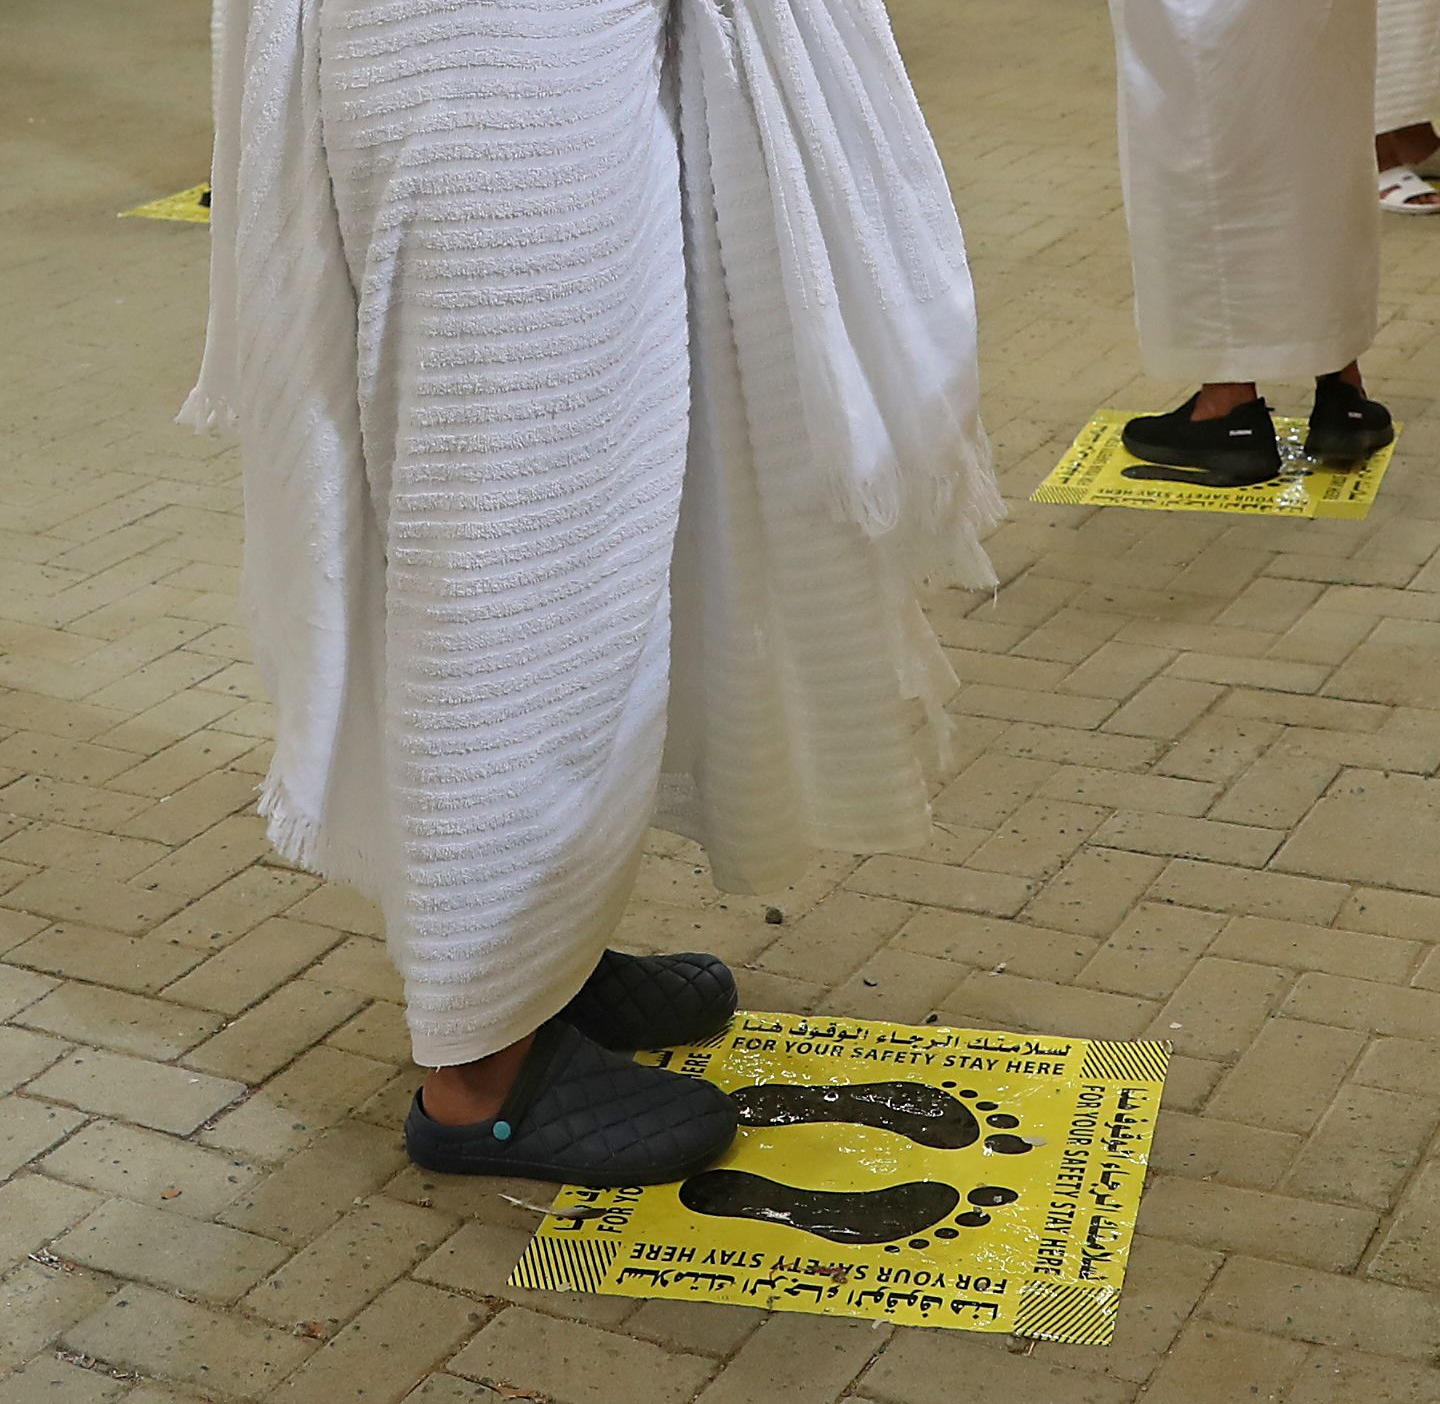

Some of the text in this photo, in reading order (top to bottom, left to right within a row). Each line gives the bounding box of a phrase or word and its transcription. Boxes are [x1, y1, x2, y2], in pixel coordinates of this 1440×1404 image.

[1096, 487, 1133, 496] HERE
[1136, 489, 1171, 499] STAY
[1175, 491, 1231, 502] SAFETY
[1235, 493, 1275, 504] YOUR
[732, 1036, 1067, 1076] FOR YOUR SAFETY STAY HERE
[742, 1018, 1072, 1057] لسلامتك الرجاء الوقوف هنا
[1033, 1084, 1106, 1277] FOR YOUR SAFETY STAY HERE
[1088, 1162, 1131, 1212] الرجاء
[596, 1185, 644, 1233] FOR YO
[630, 1242, 1008, 1294] FOR YOUR SAFETY STAY HERE
[616, 1267, 1000, 1322] لسلامتك الرجاء الوقوف هنا
